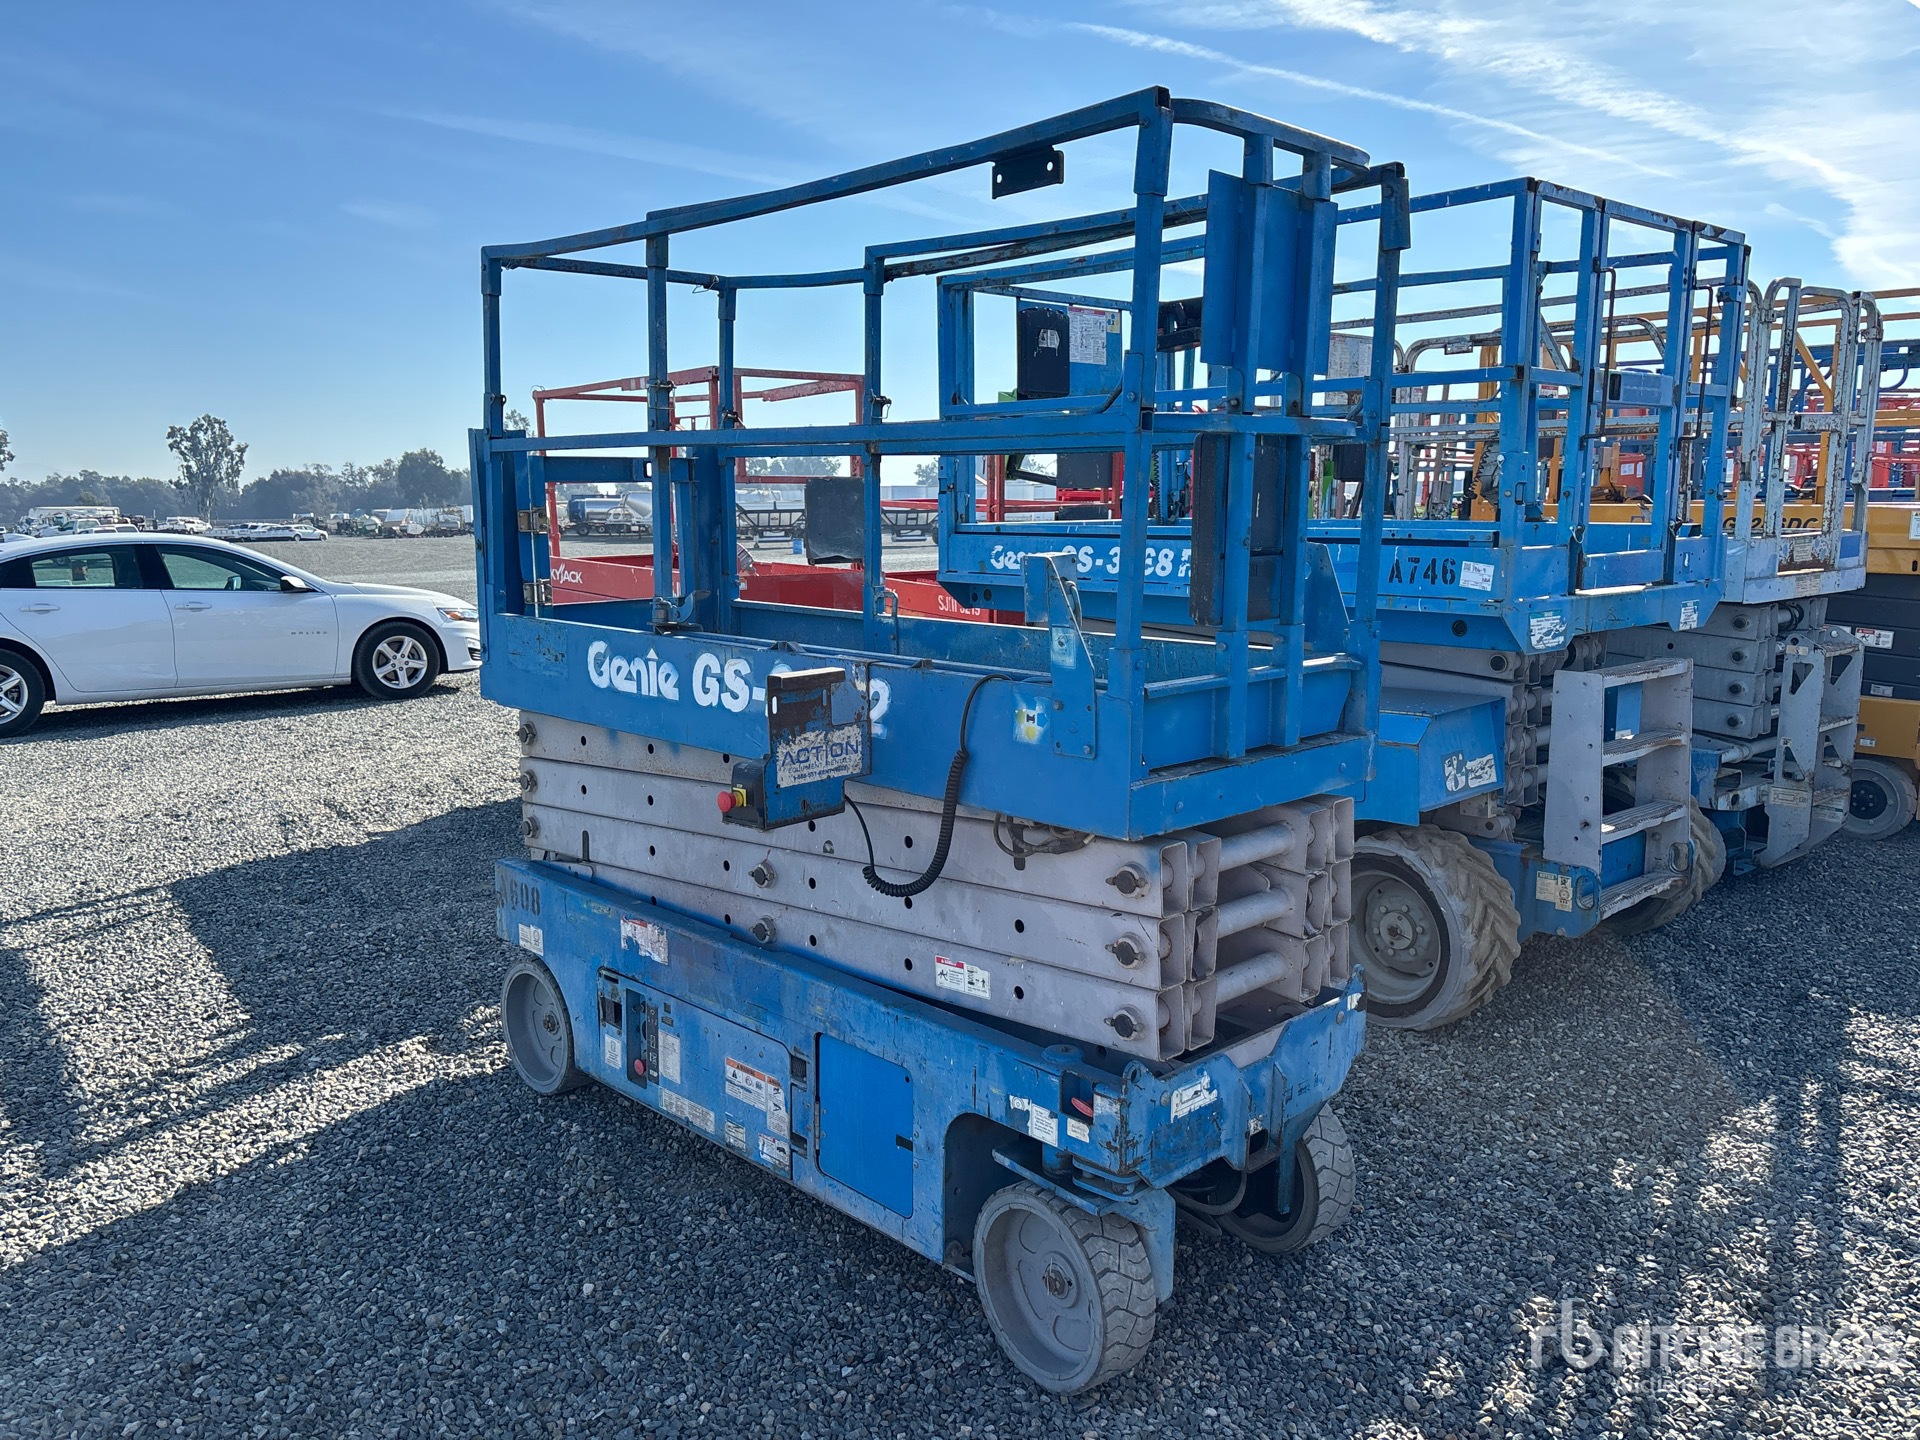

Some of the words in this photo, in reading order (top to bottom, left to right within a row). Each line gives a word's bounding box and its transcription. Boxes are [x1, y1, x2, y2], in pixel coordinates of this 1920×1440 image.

[551, 562, 583, 584] KYJACK
[1388, 557, 1456, 585] A746
[587, 640, 679, 701] Genie
[692, 652, 891, 739] GS-2
[781, 738, 860, 768] ACTION
